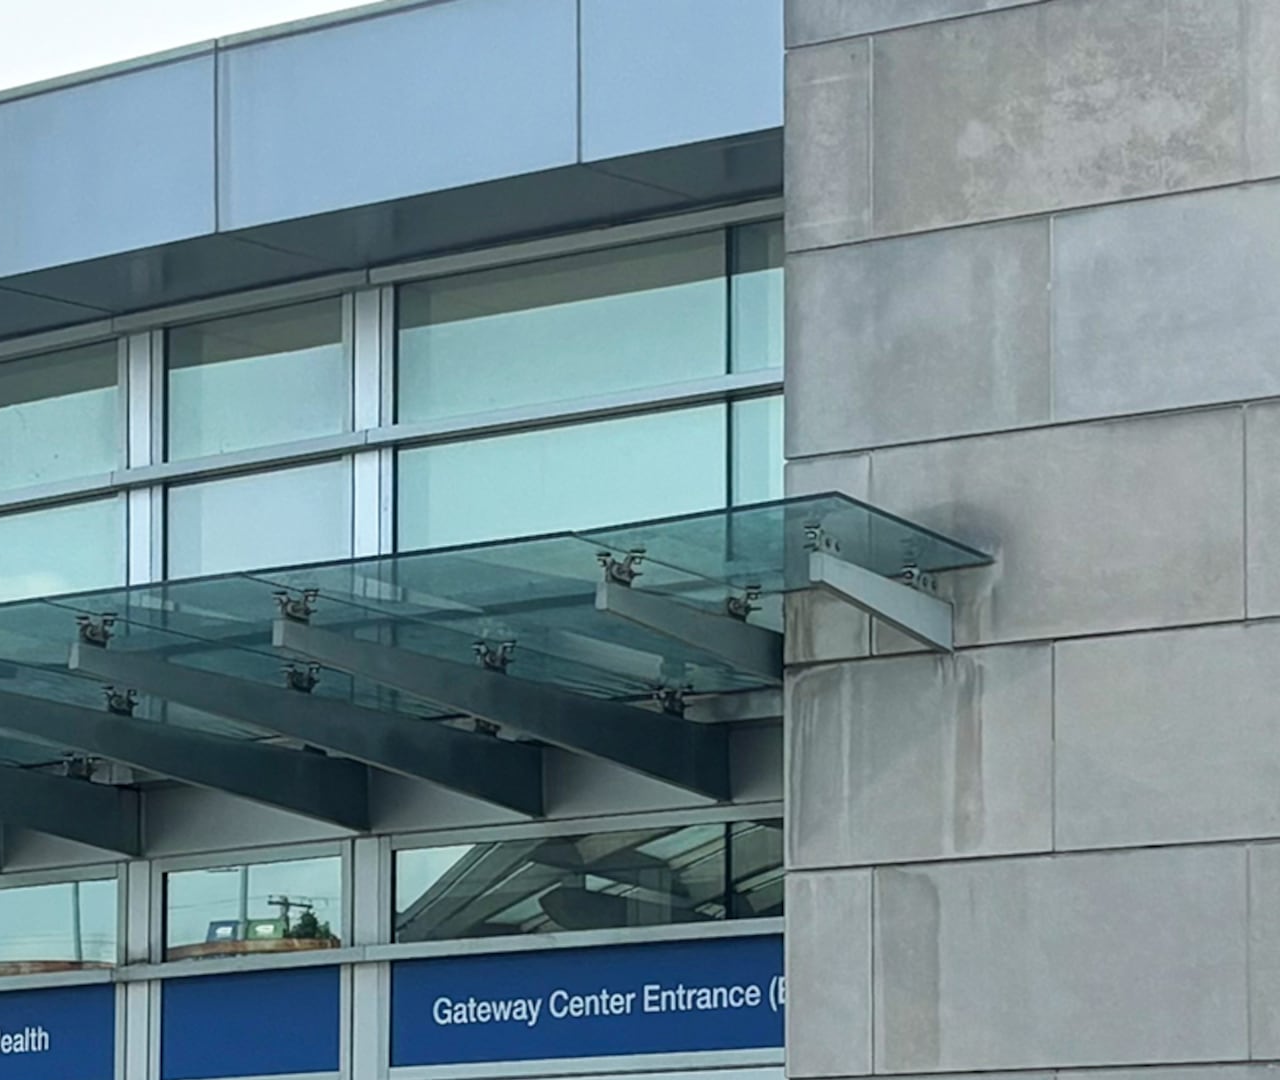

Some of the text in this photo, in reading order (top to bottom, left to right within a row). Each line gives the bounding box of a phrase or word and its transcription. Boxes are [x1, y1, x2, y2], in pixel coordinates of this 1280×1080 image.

[433, 998, 542, 1026] Gateway
[550, 989, 636, 1017] Center
[644, 984, 760, 1012] Entrance
